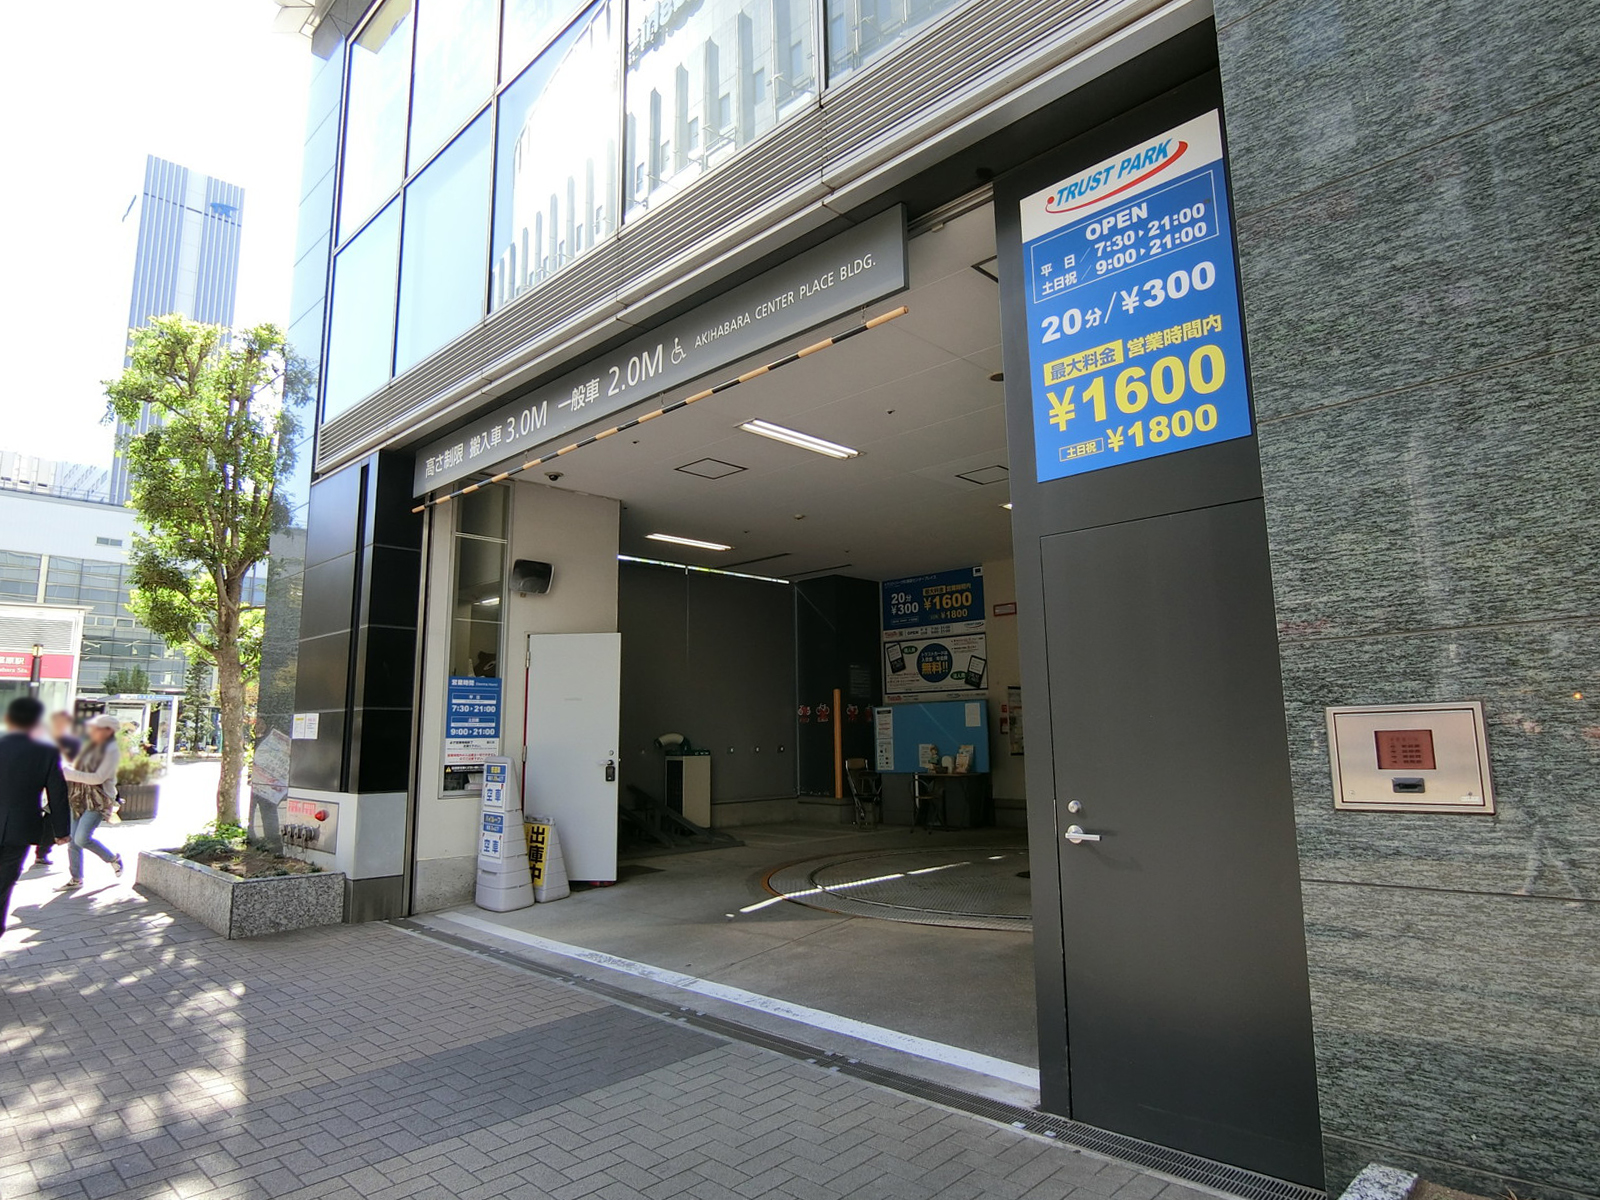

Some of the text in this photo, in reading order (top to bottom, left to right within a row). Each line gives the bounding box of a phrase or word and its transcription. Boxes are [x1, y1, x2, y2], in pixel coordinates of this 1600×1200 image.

[1056, 138, 1173, 206] TRUST PARK
[1085, 202, 1148, 240] OPEN
[1094, 229, 1135, 257] 7:30
[1148, 202, 1206, 237] 21:00
[1041, 223, 1207, 295] 土日祝 9:00 21:00
[694, 253, 876, 349] AKIHABARA CENTER PLACE BLDG.
[1050, 314, 1222, 381] 最大料金 営業時間内
[425, 343, 664, 478] 高さ制限 搬入車 3.0M 一般車 2.0M
[1046, 344, 1226, 432] ¥1600
[1066, 404, 1218, 459] 土日祝 ¥1800
[891, 602, 919, 615] ¥300
[923, 591, 972, 610] ¥1600
[528, 826, 546, 883] 出庫中
